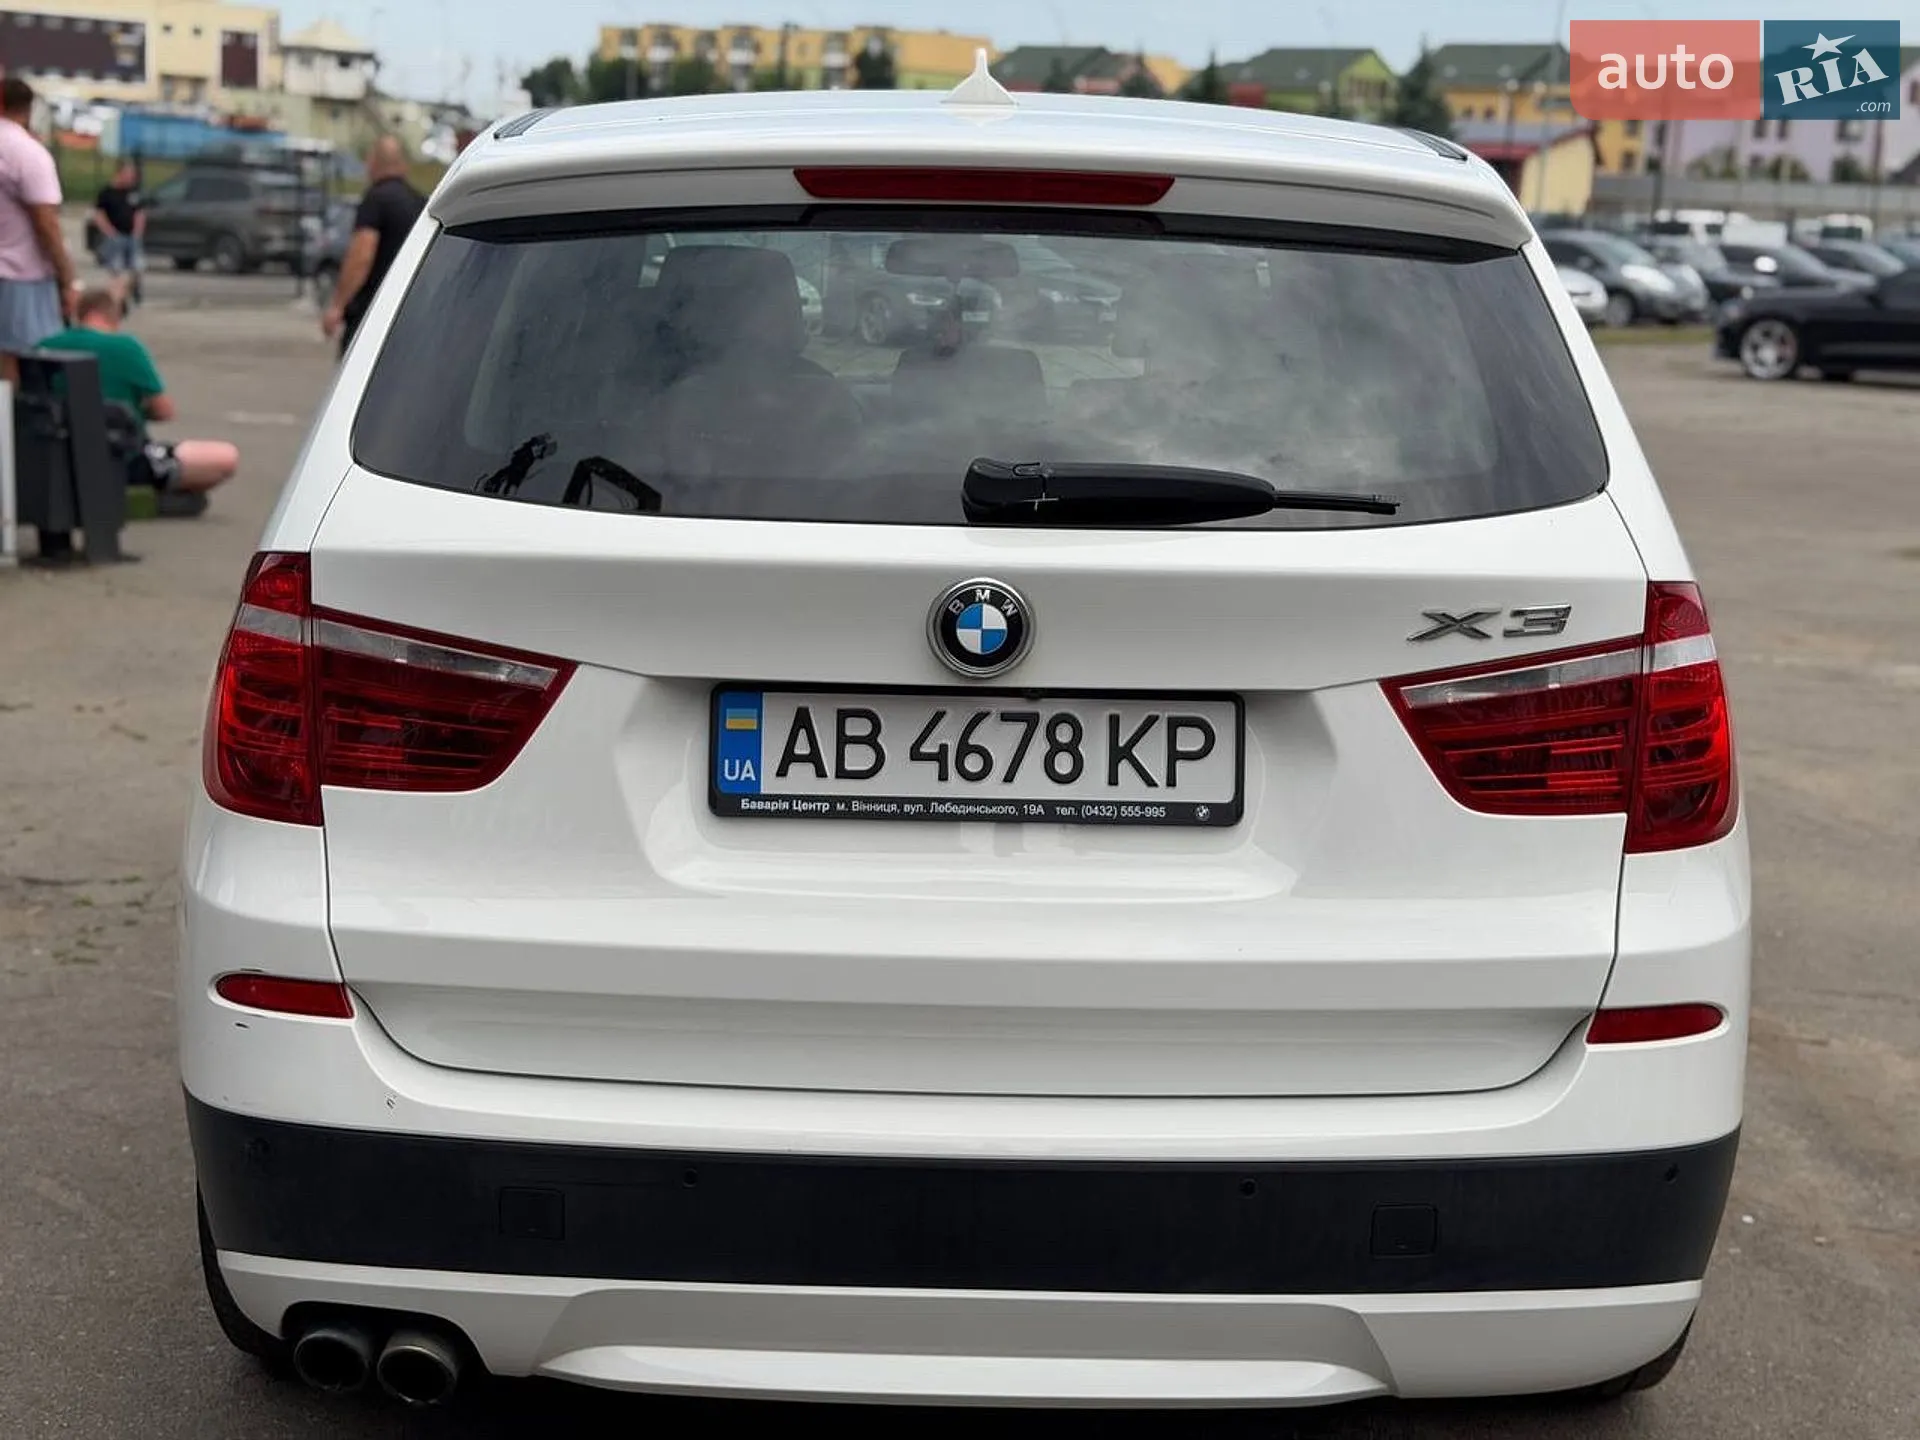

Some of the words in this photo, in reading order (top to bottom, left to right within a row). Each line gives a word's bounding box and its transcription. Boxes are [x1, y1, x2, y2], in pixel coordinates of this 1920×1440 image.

[948, 589, 1018, 617] BMW
[1406, 604, 1572, 641] X3
[775, 706, 886, 780] AB
[909, 710, 1085, 786] 4678
[1106, 713, 1216, 789] KP
[724, 759, 756, 781] UA
[740, 798, 789, 812] Баварія
[792, 799, 830, 813] Центр
[836, 802, 849, 811] м.
[851, 800, 900, 813] Вінниця,
[903, 803, 927, 815] вул.
[1055, 806, 1078, 816] тел.
[1081, 804, 1118, 819] (0432)
[1120, 805, 1166, 817] 555-995
